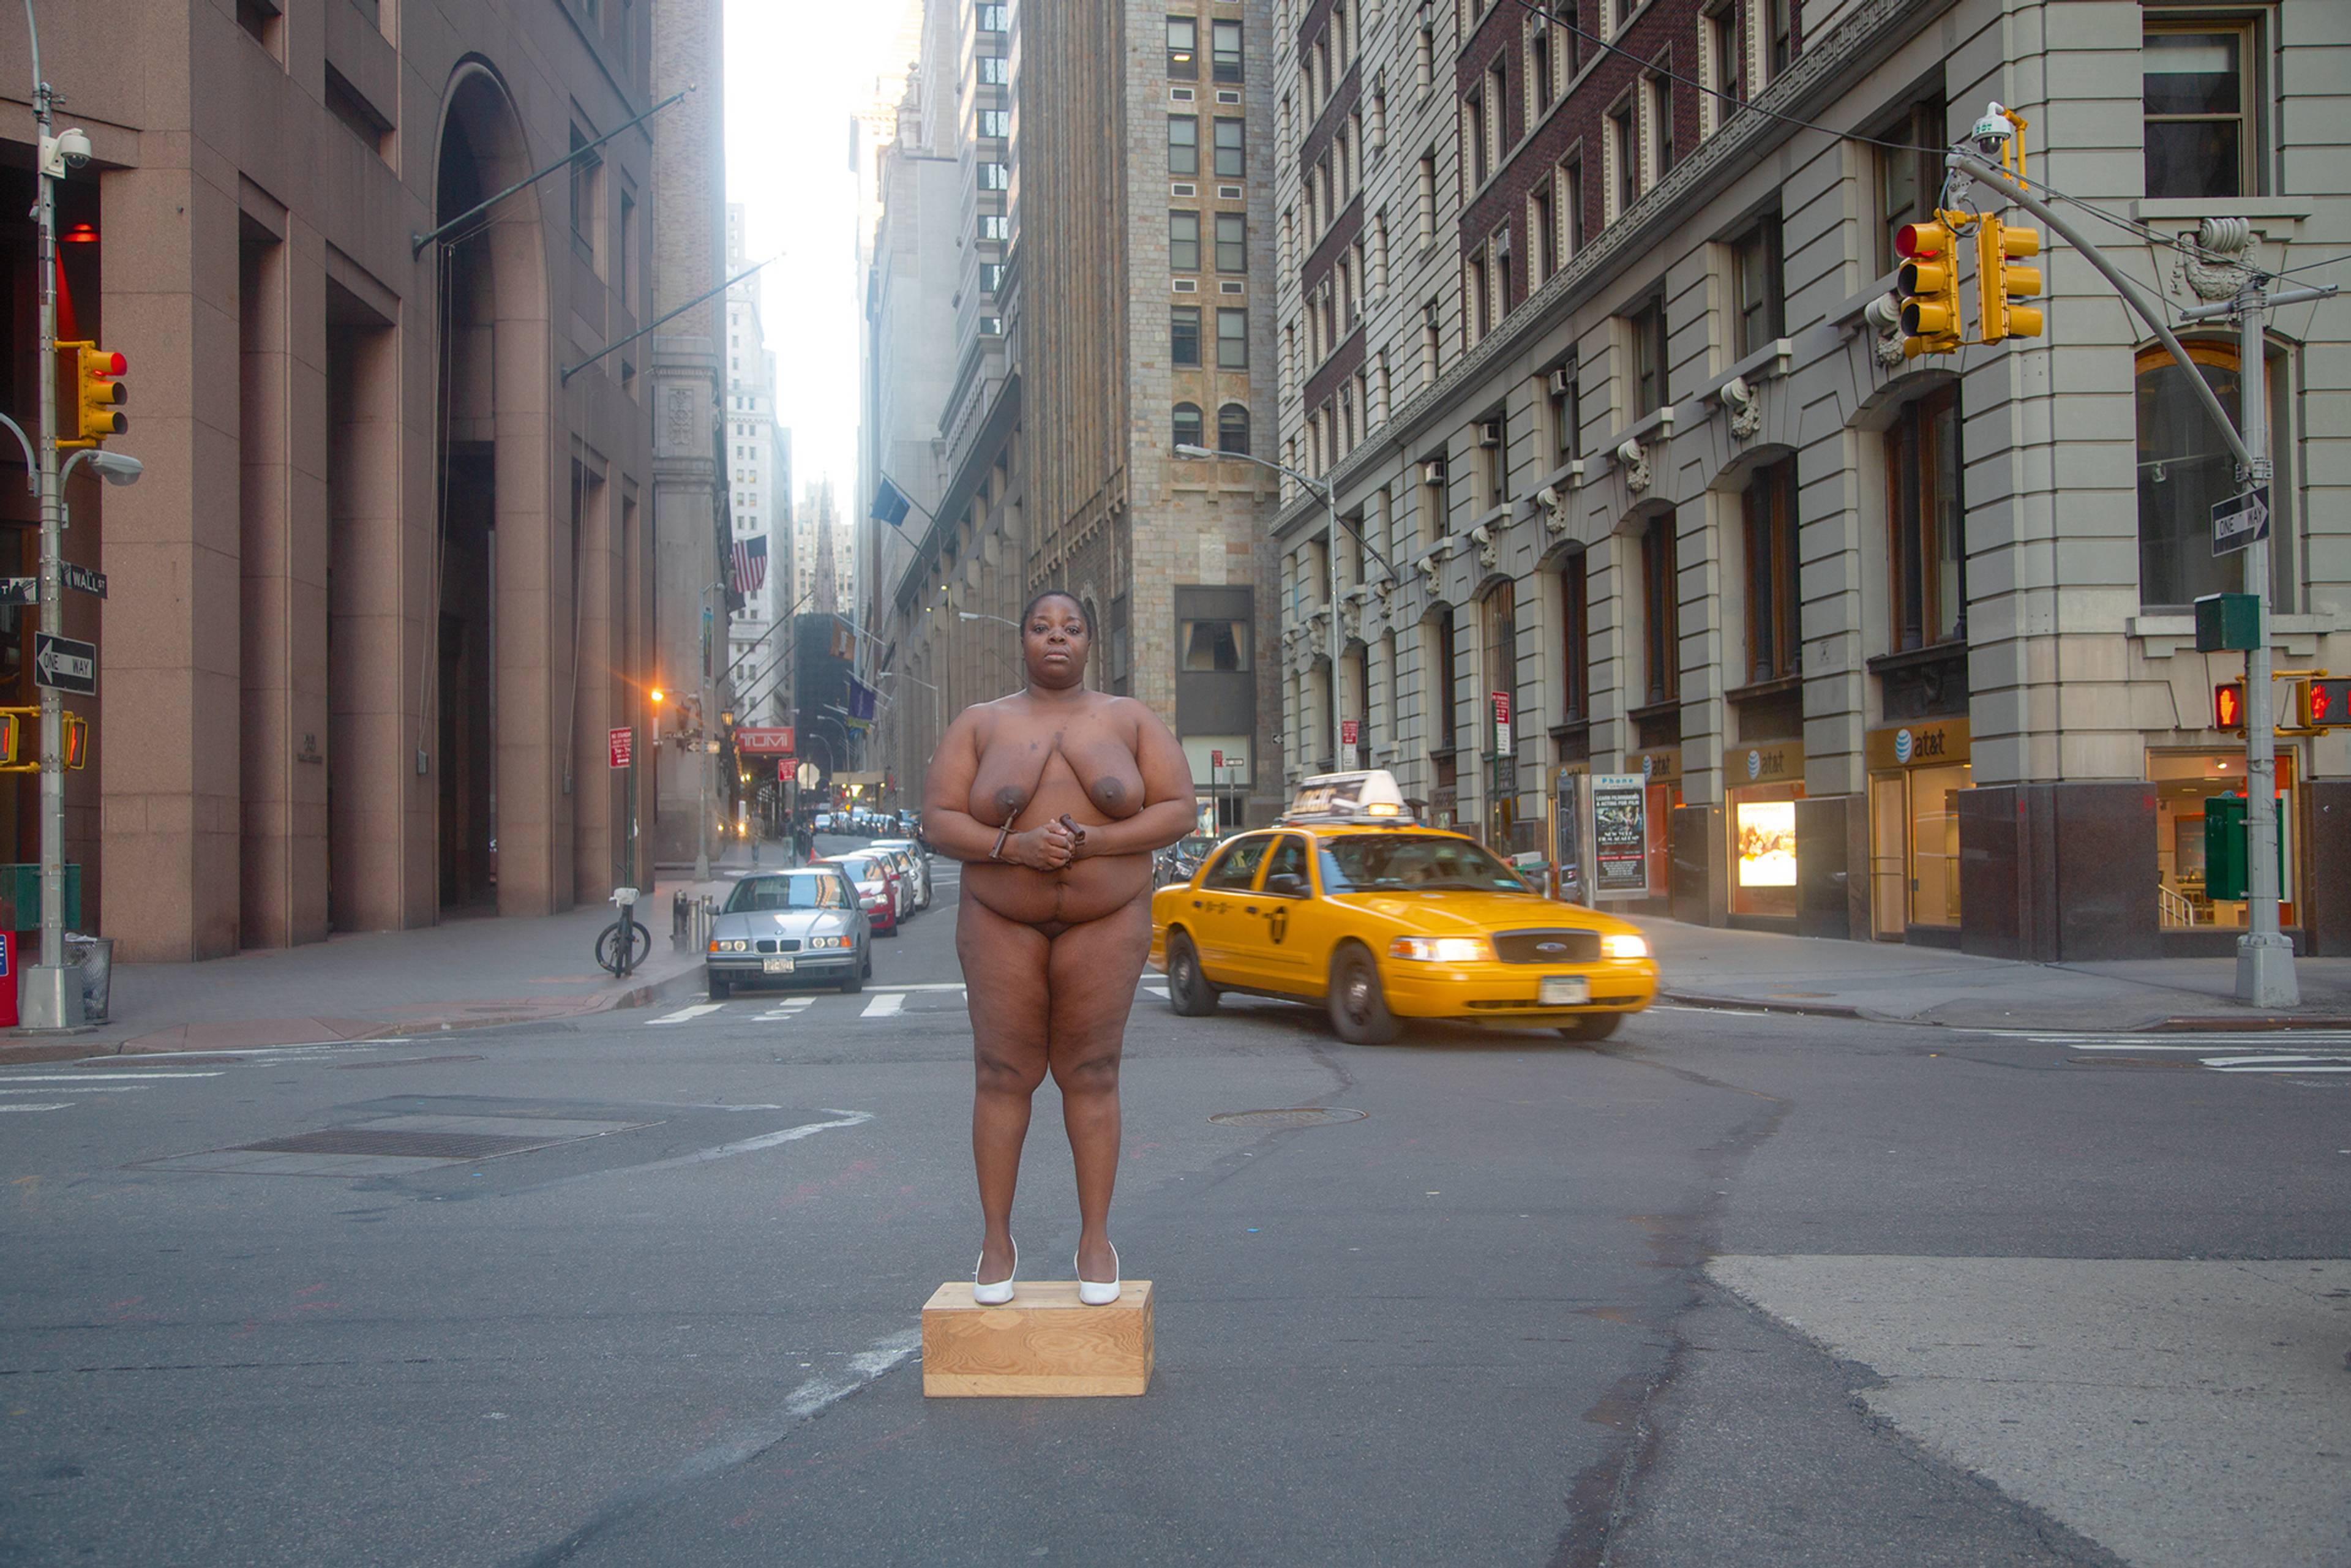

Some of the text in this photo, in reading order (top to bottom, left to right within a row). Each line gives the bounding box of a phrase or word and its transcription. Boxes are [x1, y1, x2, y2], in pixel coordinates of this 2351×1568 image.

[2219, 506, 2263, 536] ONE WAY
[73, 571, 105, 592] WALL ST
[44, 653, 89, 675] ONE WAY
[740, 733, 787, 747] TUMI
[1914, 728, 1945, 757] at&t
[1761, 750, 1784, 775] at&t
